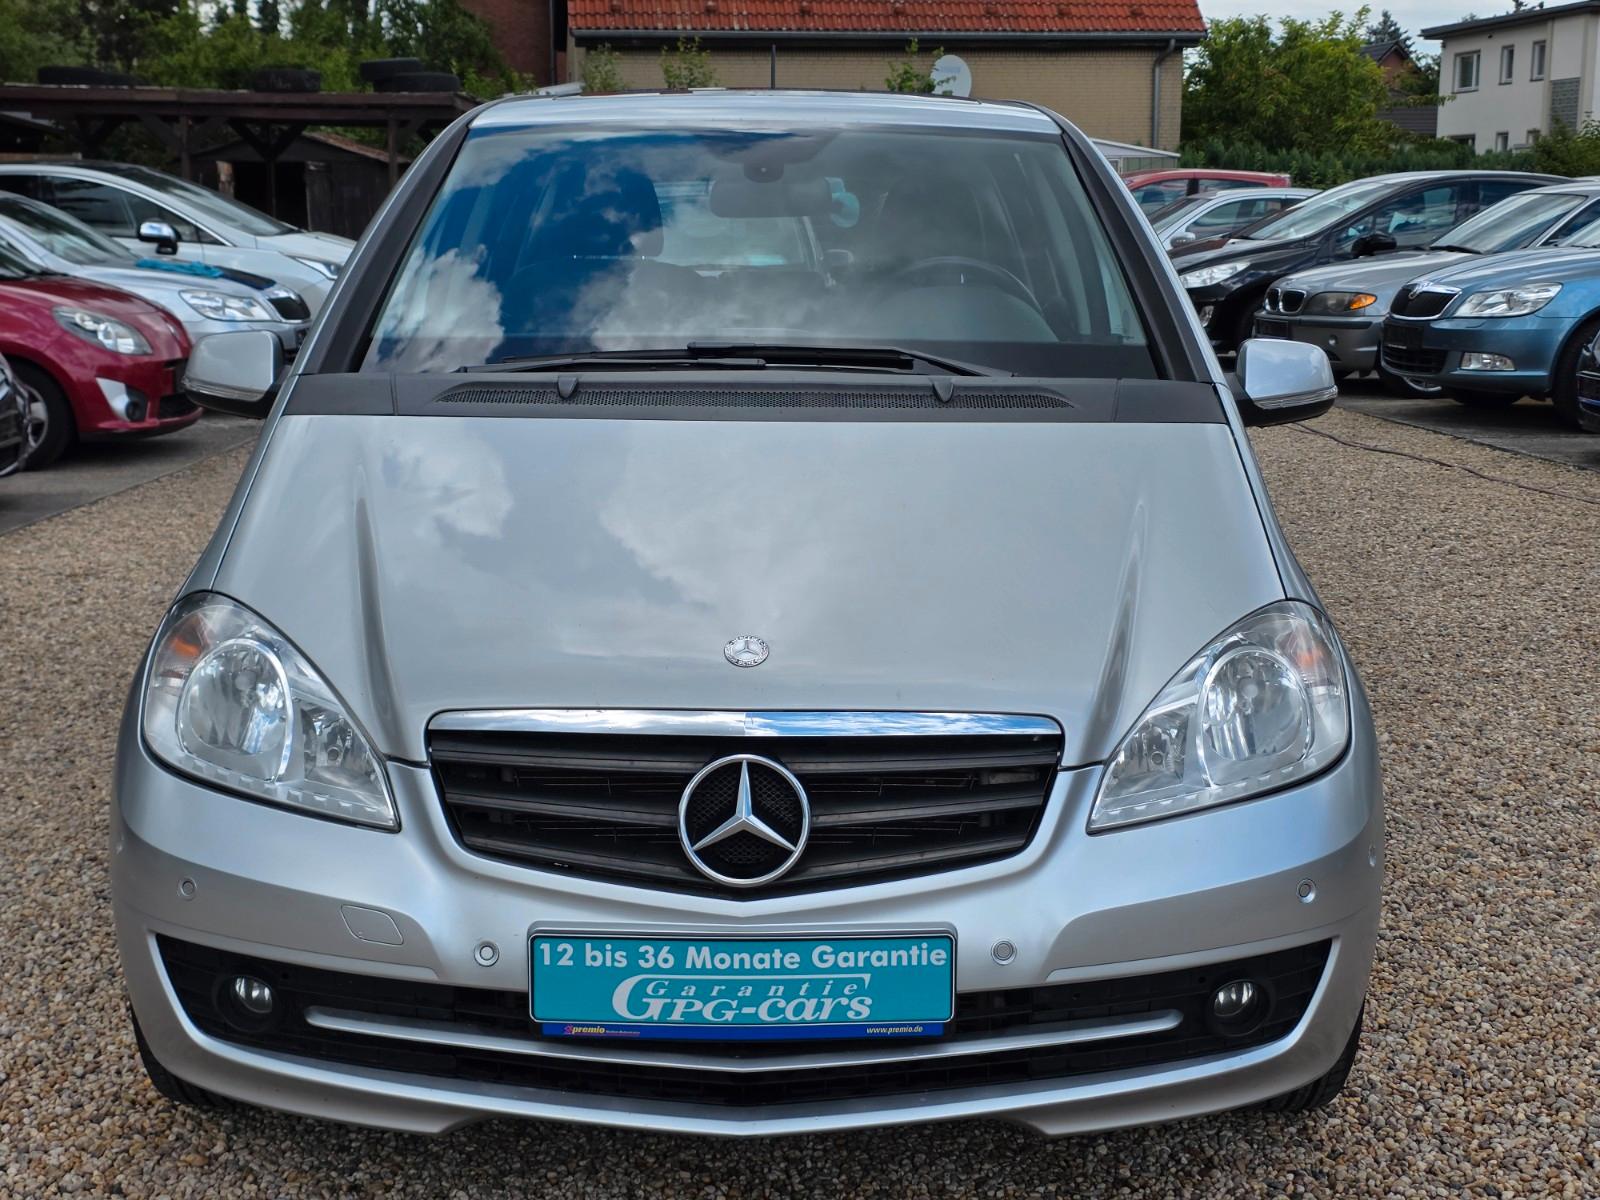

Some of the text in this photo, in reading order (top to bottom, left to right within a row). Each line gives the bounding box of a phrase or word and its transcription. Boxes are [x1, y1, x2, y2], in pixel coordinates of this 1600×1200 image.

[540, 942, 947, 970] 12 bis 36 Monate Garantie
[646, 979, 858, 997] Garantie
[611, 973, 873, 1022] GPG-cars
[572, 1025, 606, 1035] premio
[866, 1025, 924, 1035] www.premio.de
